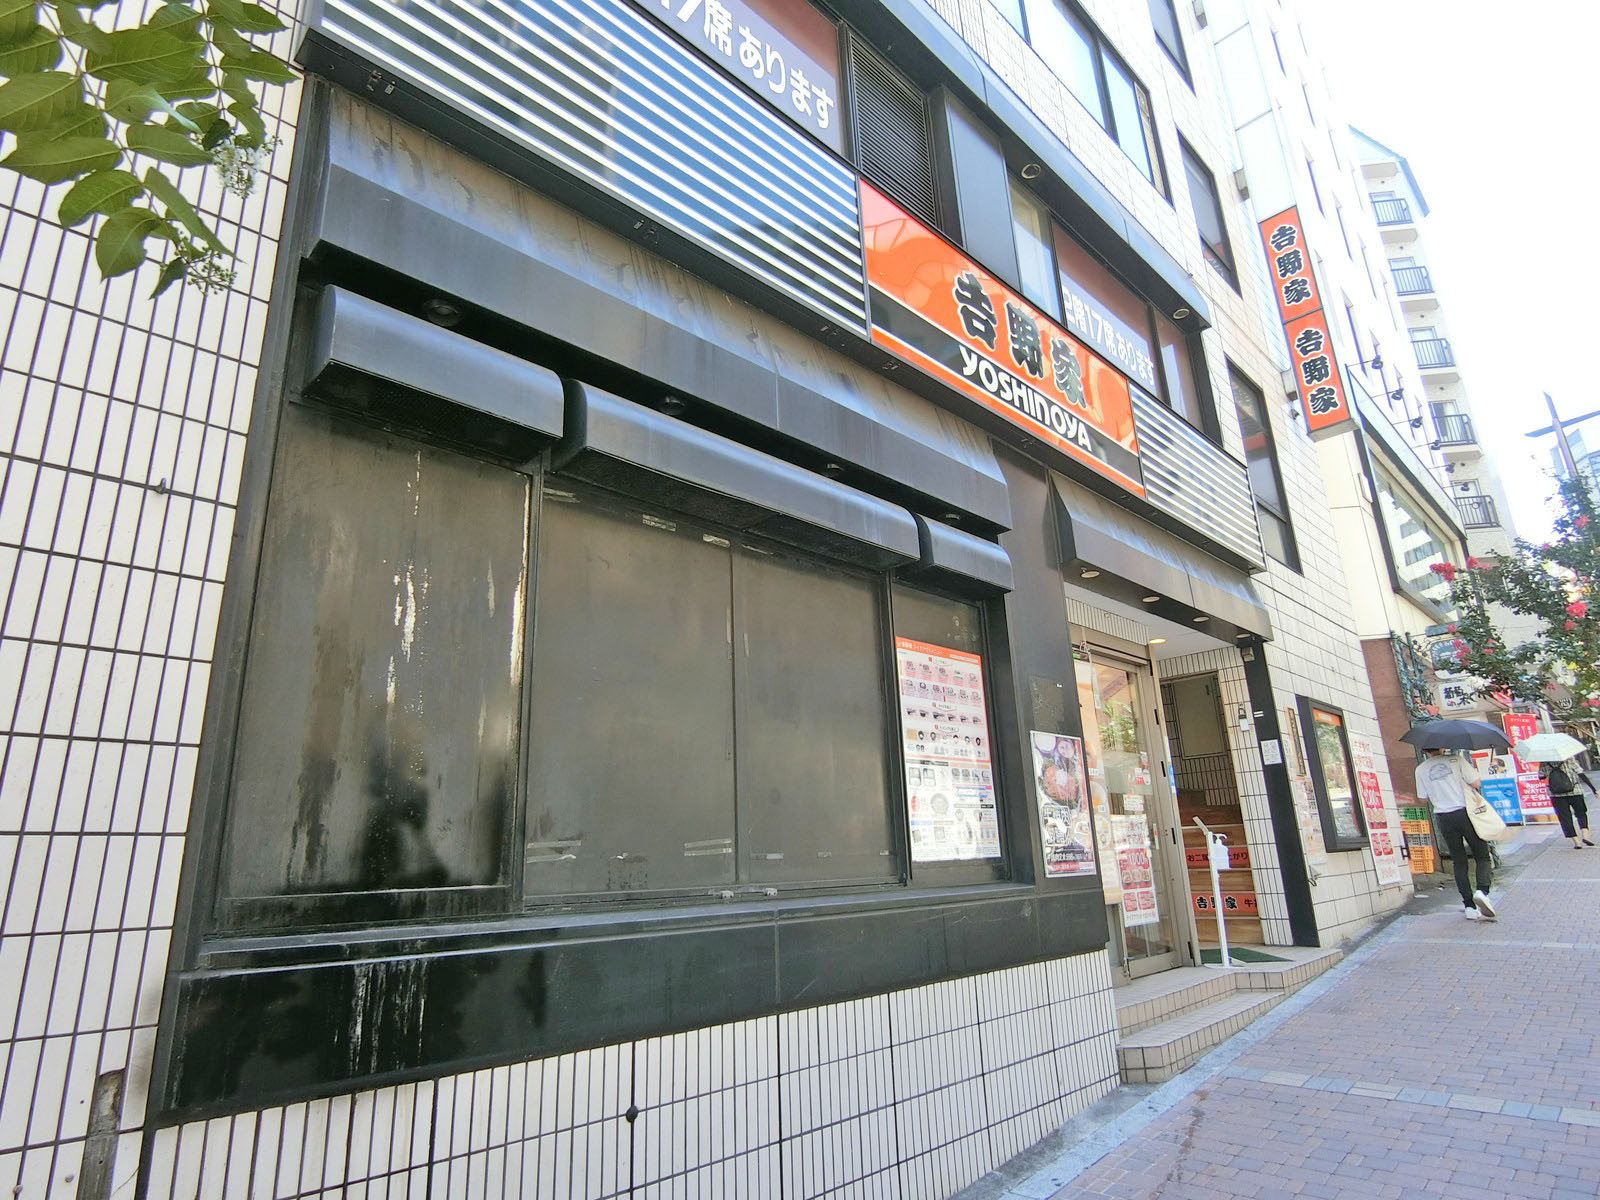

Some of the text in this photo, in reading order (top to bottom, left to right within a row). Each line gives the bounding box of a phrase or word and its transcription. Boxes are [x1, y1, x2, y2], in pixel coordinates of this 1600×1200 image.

[661, 0, 835, 129] 席あります
[1269, 225, 1312, 307] 吉野家
[953, 271, 1087, 409] 吉野家
[1062, 285, 1154, 385] 2階17席あります
[1295, 328, 1339, 415] 吉野家
